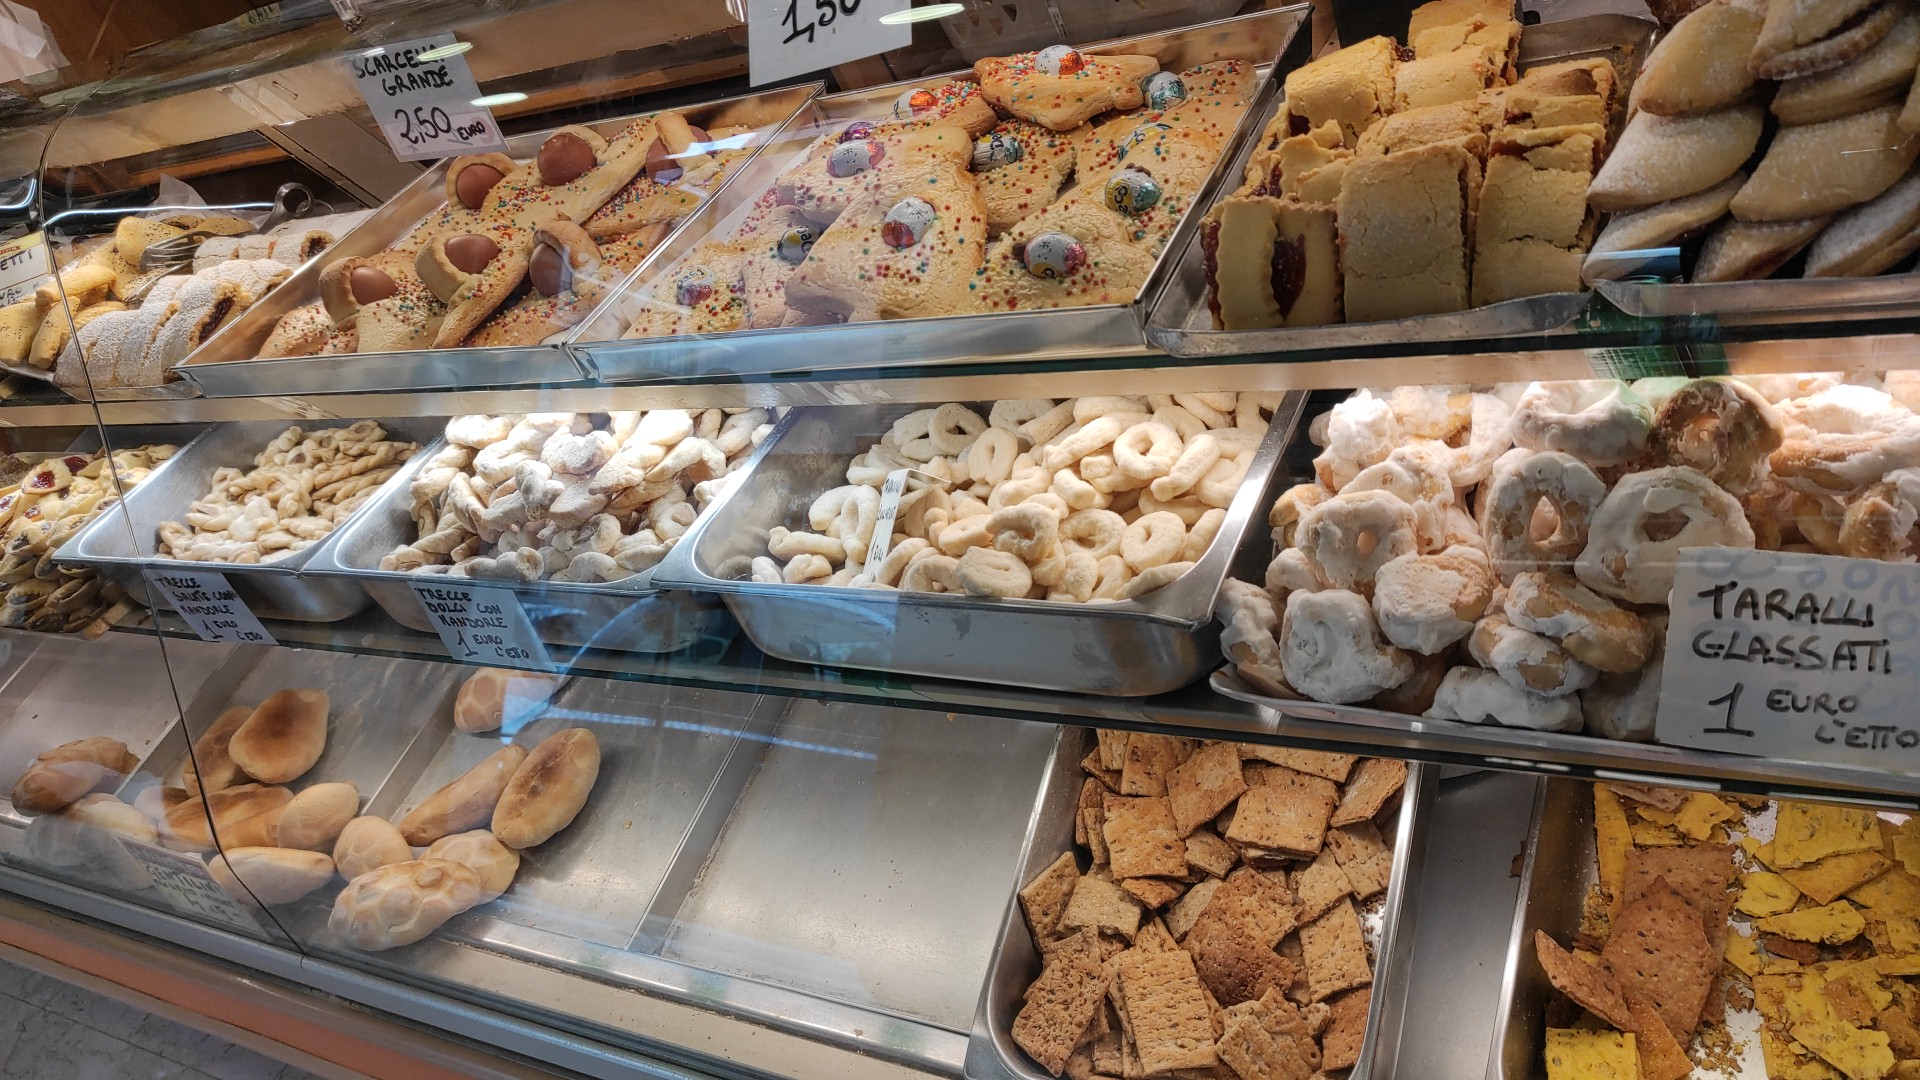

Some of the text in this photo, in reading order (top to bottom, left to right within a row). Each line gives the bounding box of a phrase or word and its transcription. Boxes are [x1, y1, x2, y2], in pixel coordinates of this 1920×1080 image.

[382, 65, 454, 96] GRANDE
[395, 106, 486, 145] 2,50 EURO
[413, 587, 473, 602] TRECCE
[424, 601, 502, 615] DOLCI CON
[1697, 580, 1874, 628] TARALLI
[202, 620, 239, 639] 1 EURO
[437, 614, 508, 629] MANDORLE
[457, 630, 504, 657] 1 EURO
[1692, 629, 1892, 675] GLASSATI
[1703, 682, 1858, 738] 1 EURO
[1814, 718, 1920, 750] L'ETTO
